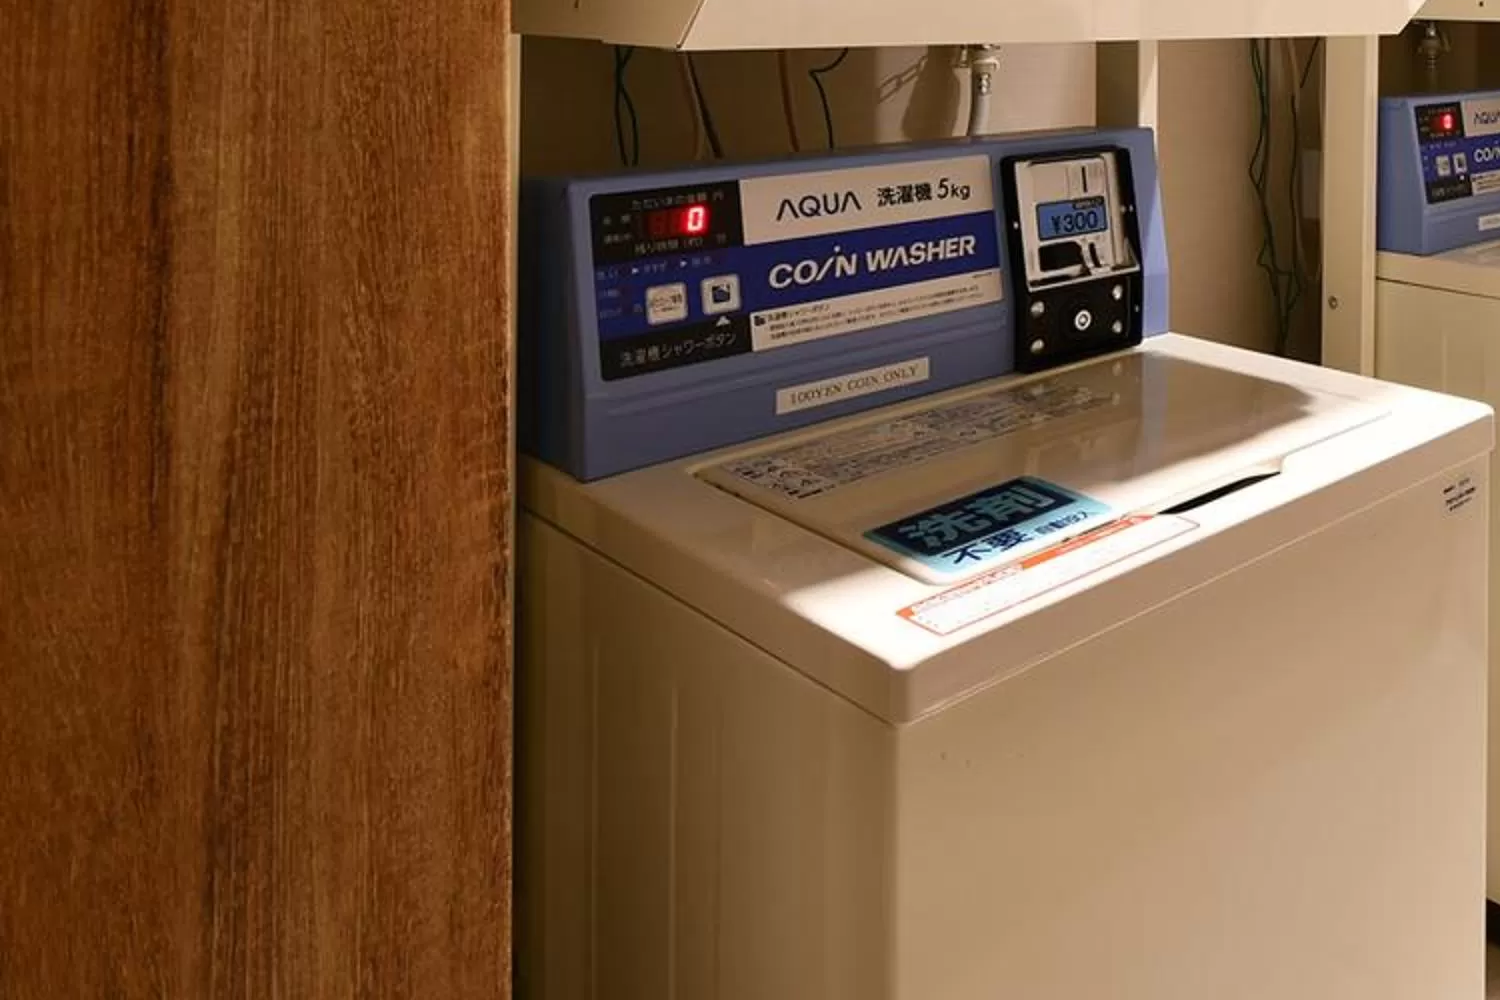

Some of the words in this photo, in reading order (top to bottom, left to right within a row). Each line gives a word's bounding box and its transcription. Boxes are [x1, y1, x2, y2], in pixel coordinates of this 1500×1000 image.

[776, 191, 862, 222] AQUA
[877, 182, 932, 208] 洗濯機
[937, 178, 971, 201] 5kg
[687, 205, 706, 232] 0
[1051, 210, 1098, 235] ¥300
[769, 245, 857, 289] COIN
[866, 235, 976, 273] WASHER
[847, 375, 878, 392] COIN
[883, 363, 919, 381] ONLY
